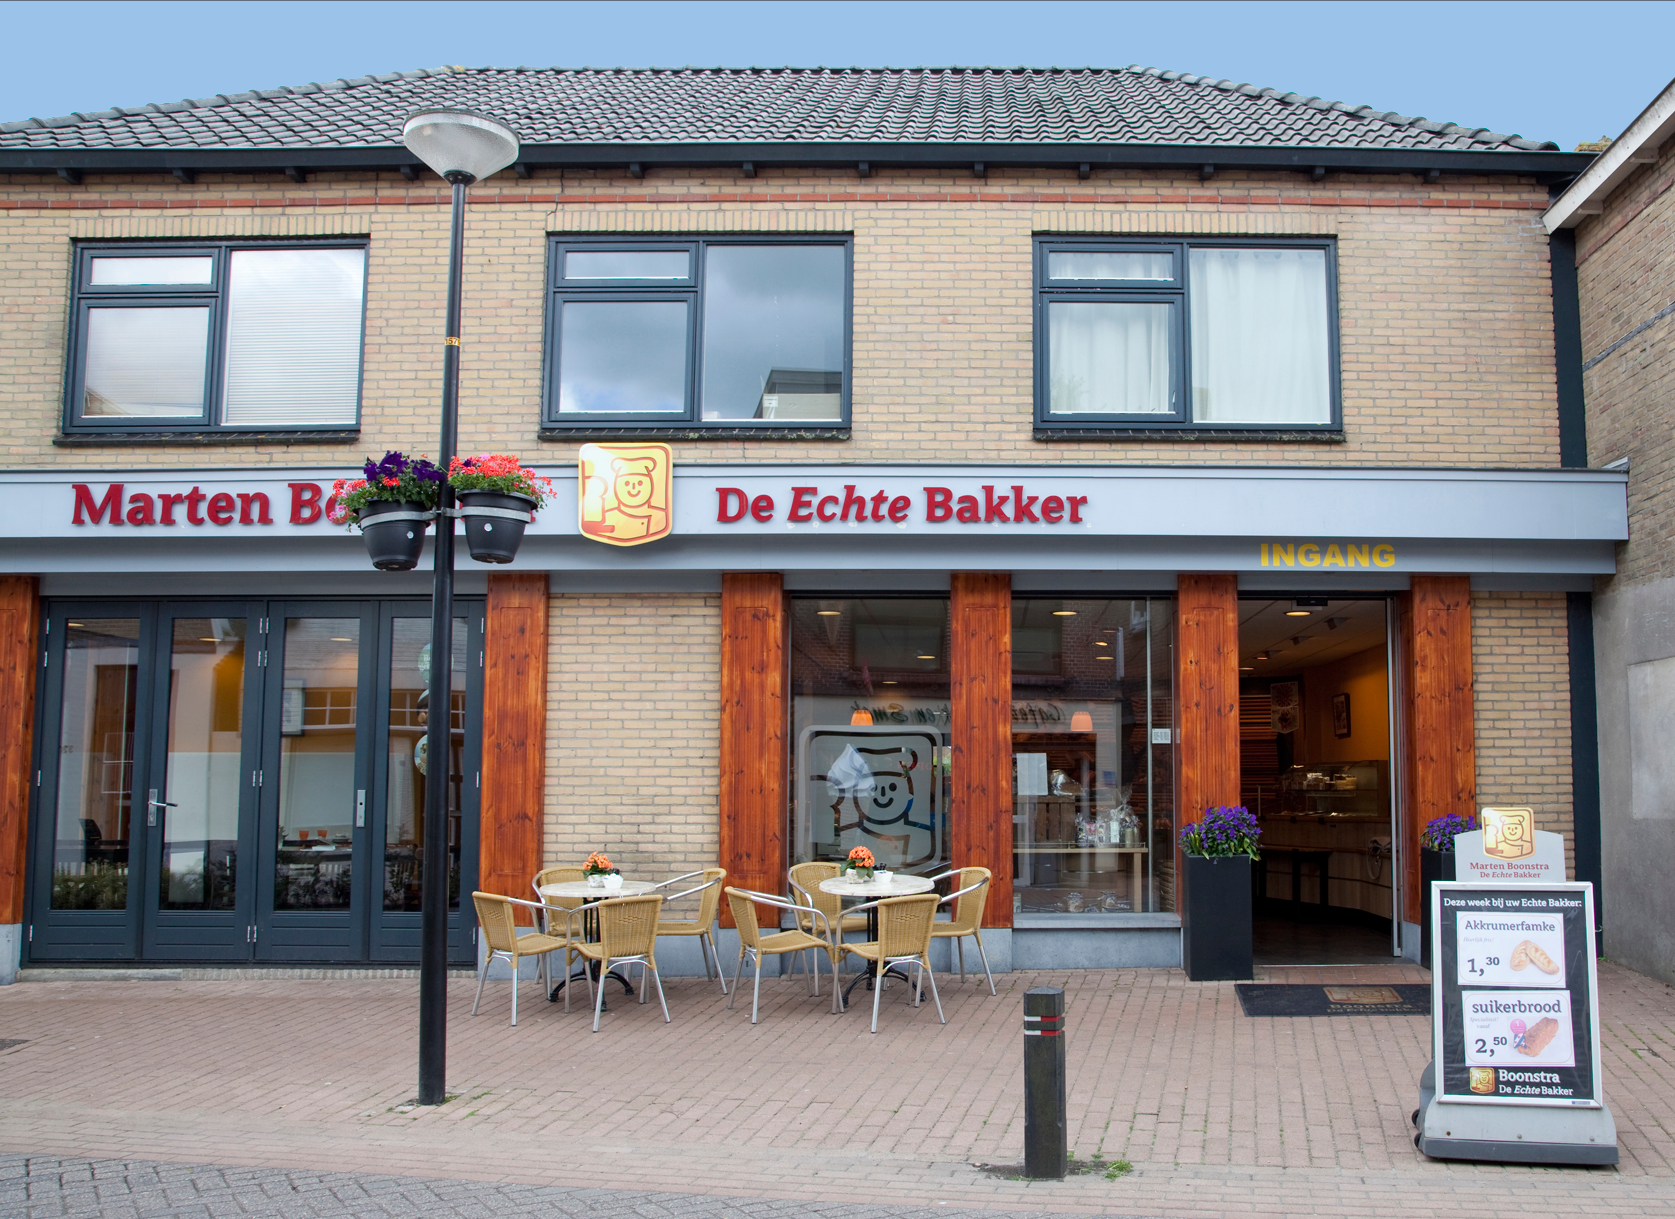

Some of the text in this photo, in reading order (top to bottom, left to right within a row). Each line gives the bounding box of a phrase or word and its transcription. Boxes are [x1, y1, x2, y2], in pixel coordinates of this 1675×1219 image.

[71, 483, 274, 526] Marten
[716, 485, 1088, 523] De Echte Bakker
[1261, 543, 1396, 567] INGANG
[1469, 862, 1549, 870] Marten Boonstra
[1480, 871, 1541, 879] De Echte Bakker
[1444, 898, 1583, 909] Deze week bij uw Echte Bakker:
[1464, 920, 1556, 932] Akkrumerfamke
[1471, 1000, 1563, 1014] suikerbrood
[1498, 1069, 1561, 1083] Boonstra
[1499, 1085, 1574, 1096] De Echte Bakker
